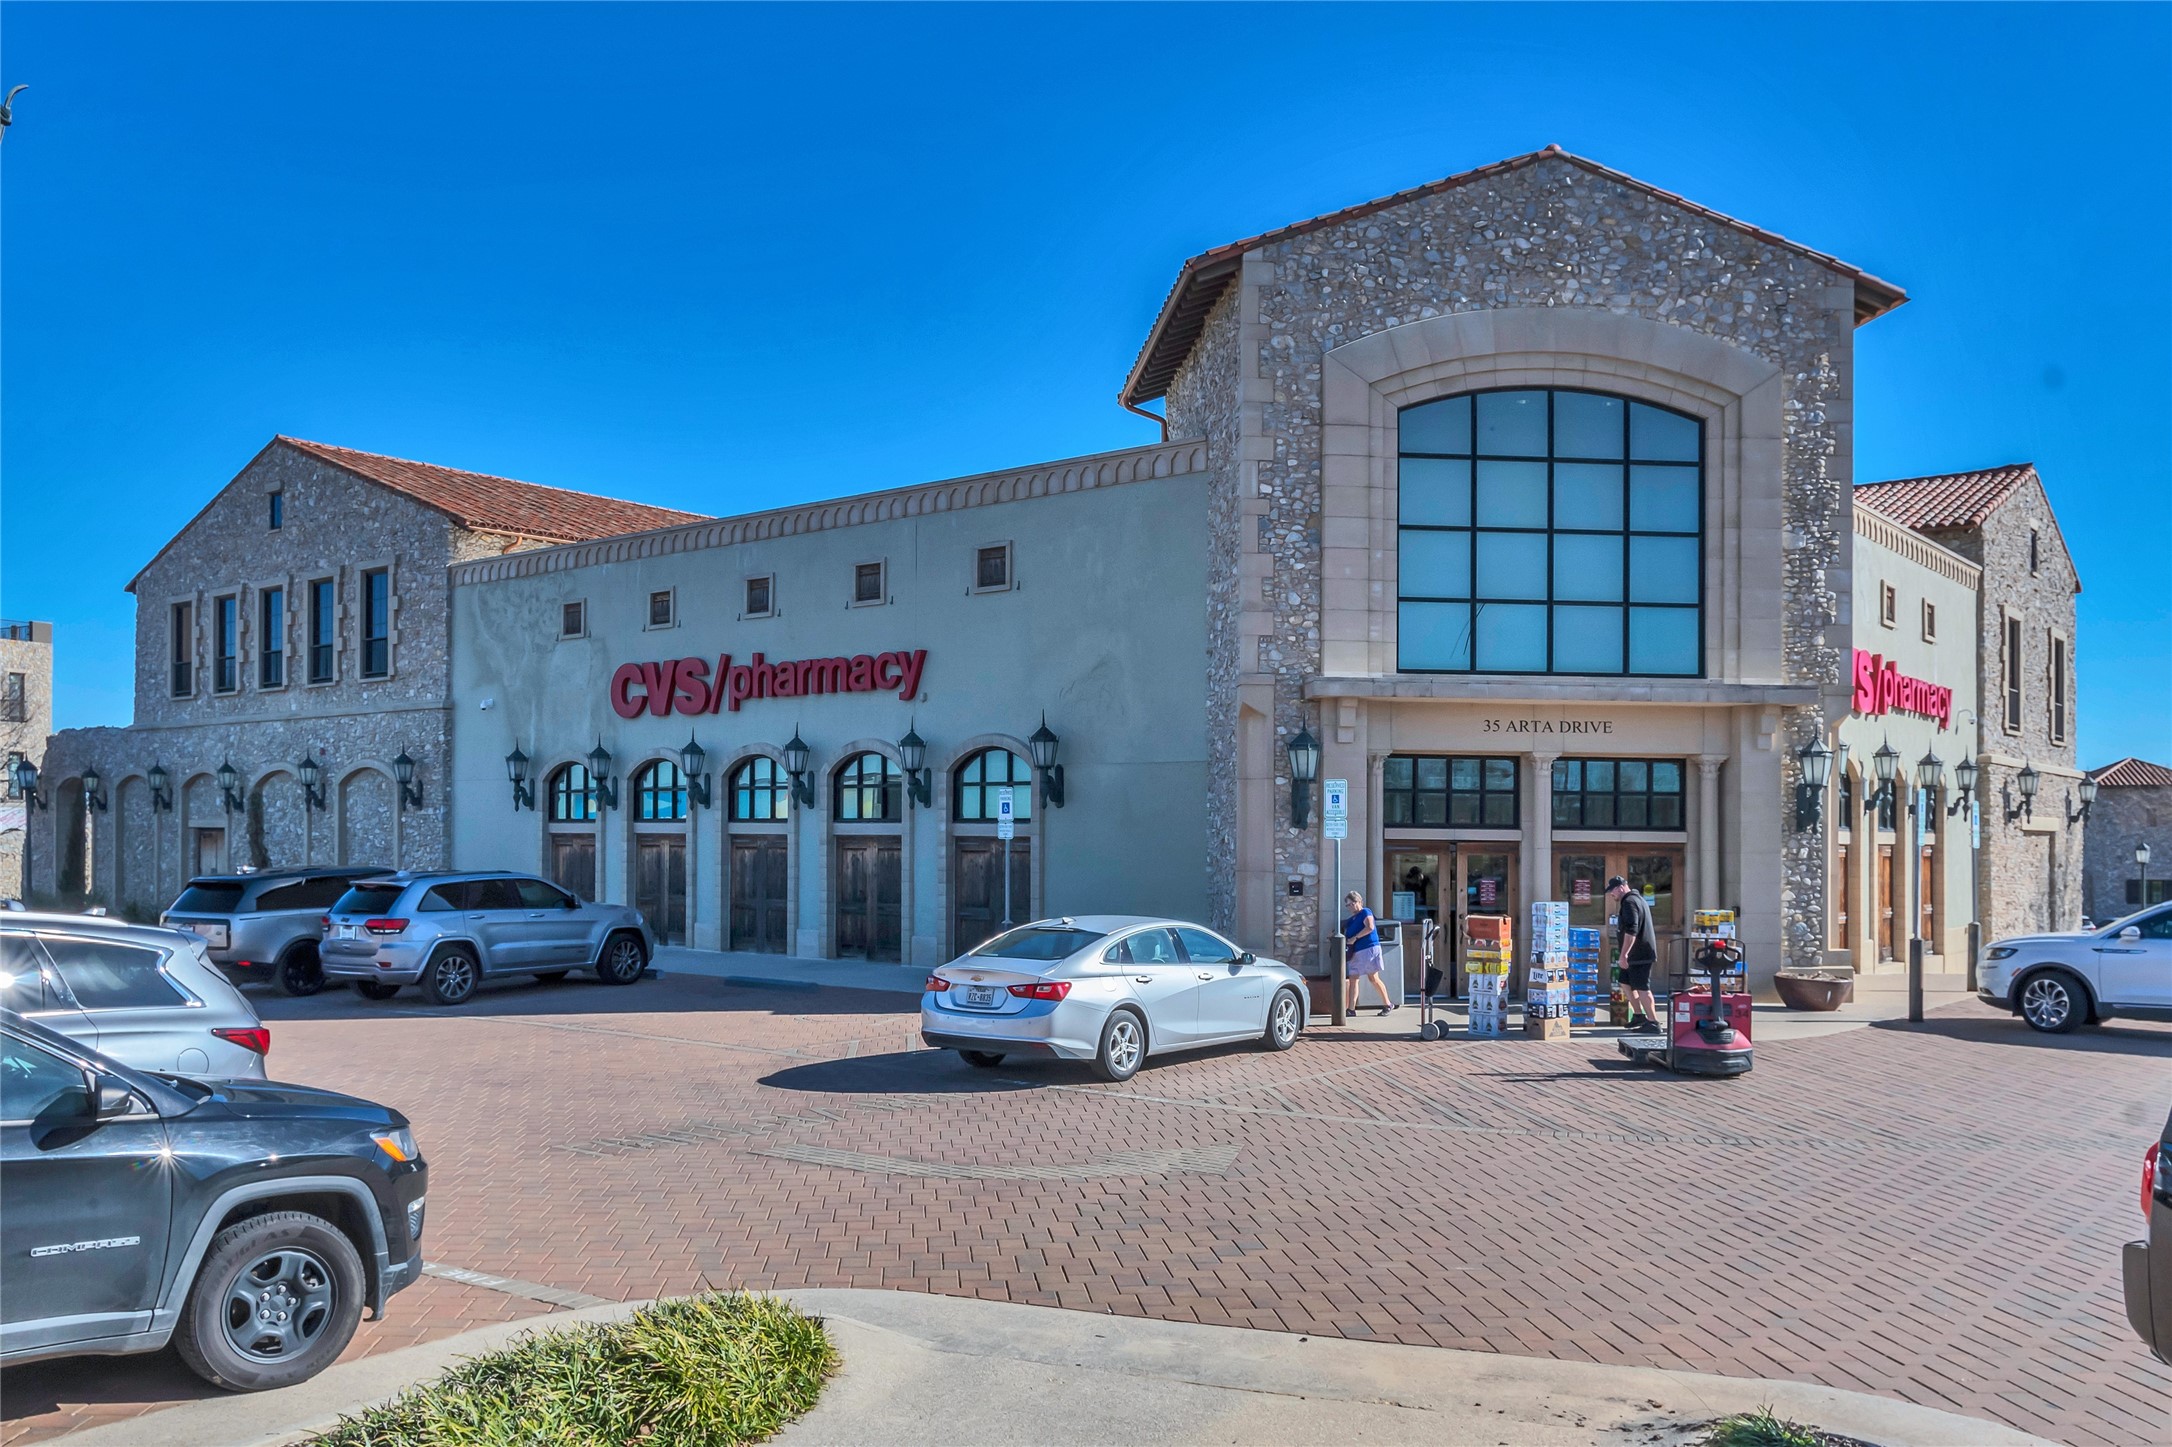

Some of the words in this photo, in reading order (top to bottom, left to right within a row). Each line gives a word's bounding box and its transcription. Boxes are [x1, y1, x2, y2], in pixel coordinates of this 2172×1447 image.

[611, 650, 927, 718] CVS/pharmacy
[1852, 648, 1953, 730] S/pharmacy
[1483, 719, 1500, 733] 35
[1506, 720, 1554, 733] ARTA
[1559, 720, 1613, 734] DRIVE
[31, 1236, 140, 1257] COMPASS
